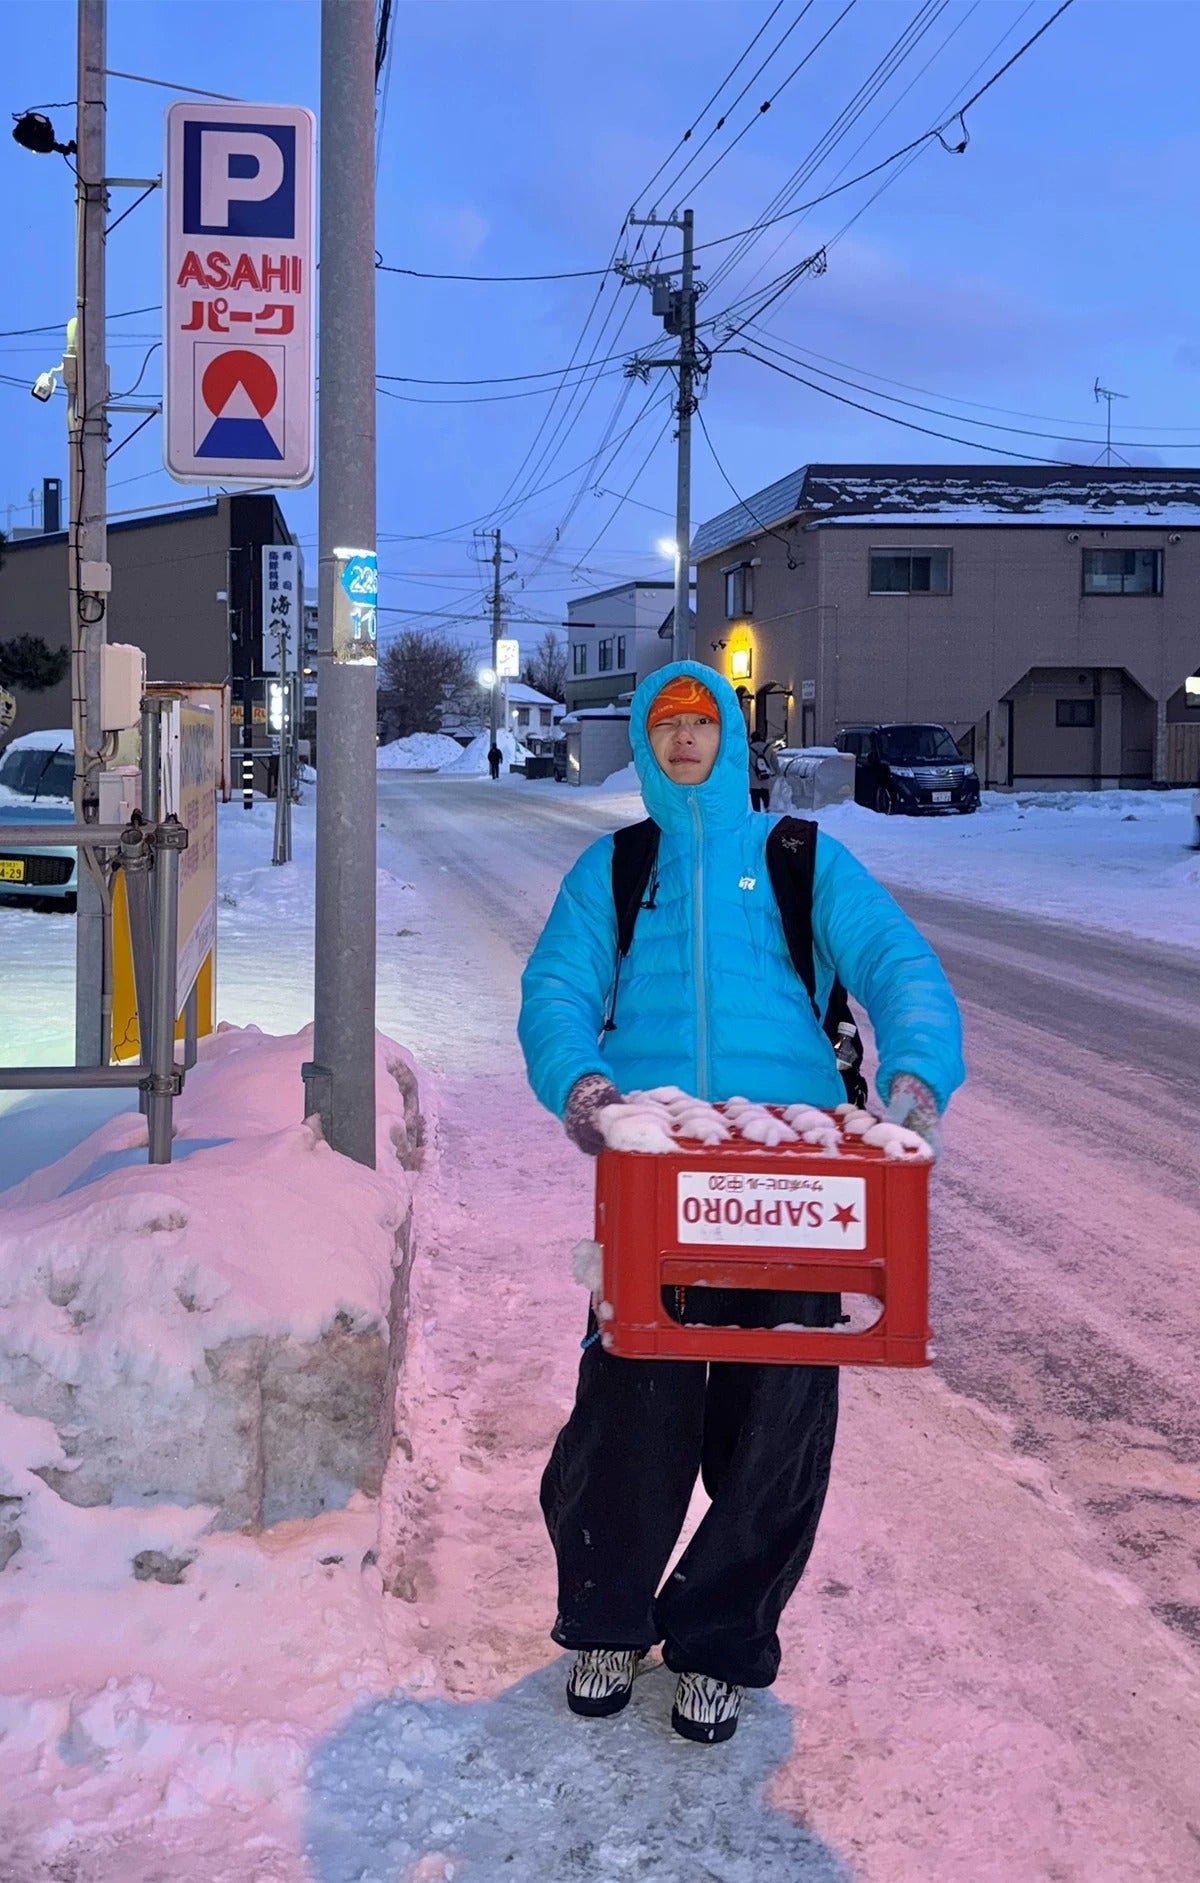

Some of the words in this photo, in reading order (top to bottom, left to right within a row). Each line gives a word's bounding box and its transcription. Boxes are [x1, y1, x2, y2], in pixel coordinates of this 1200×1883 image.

[200, 129, 284, 228] P
[177, 250, 302, 294] ASAHI
[181, 297, 295, 335] パーク
[683, 1197, 824, 1228] SAPPORO
